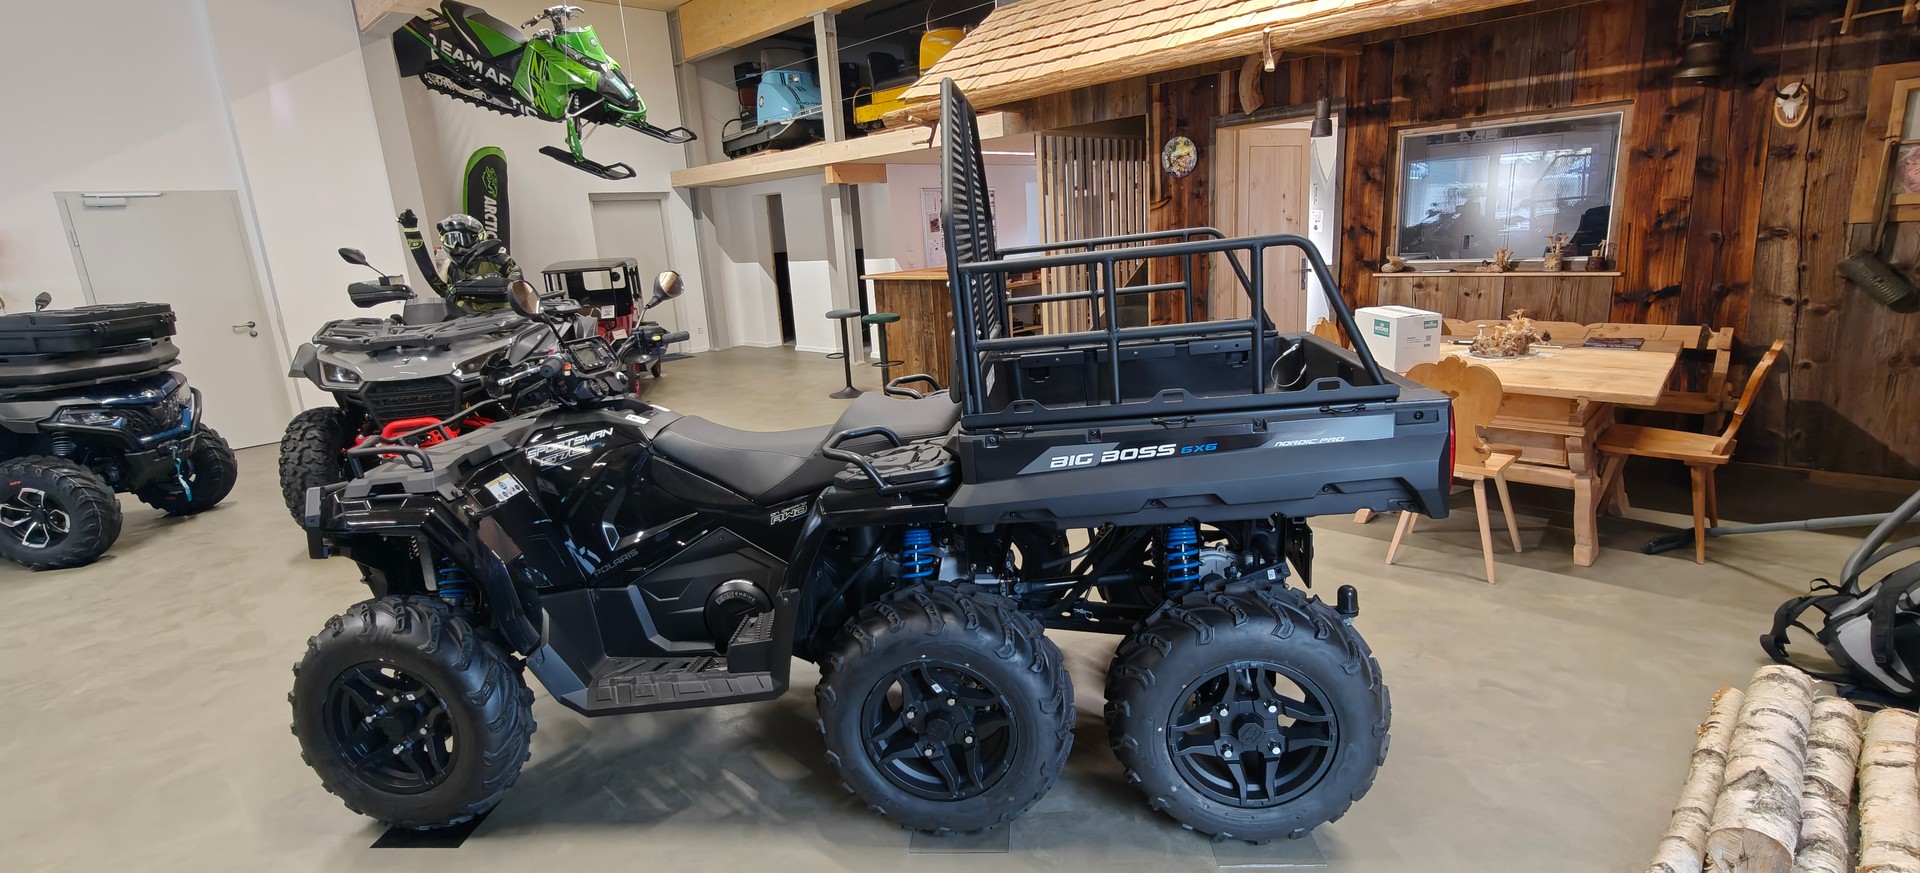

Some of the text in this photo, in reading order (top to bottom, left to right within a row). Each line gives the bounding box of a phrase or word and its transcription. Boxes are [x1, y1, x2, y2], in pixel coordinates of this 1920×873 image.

[484, 195, 498, 240] ARCTIC
[526, 427, 614, 459] SPORTSMAN
[1050, 453, 1094, 468] BIG
[1101, 444, 1177, 463] BOSS
[1274, 436, 1345, 447] NORDIC PRO
[594, 548, 639, 578] POLARIS
